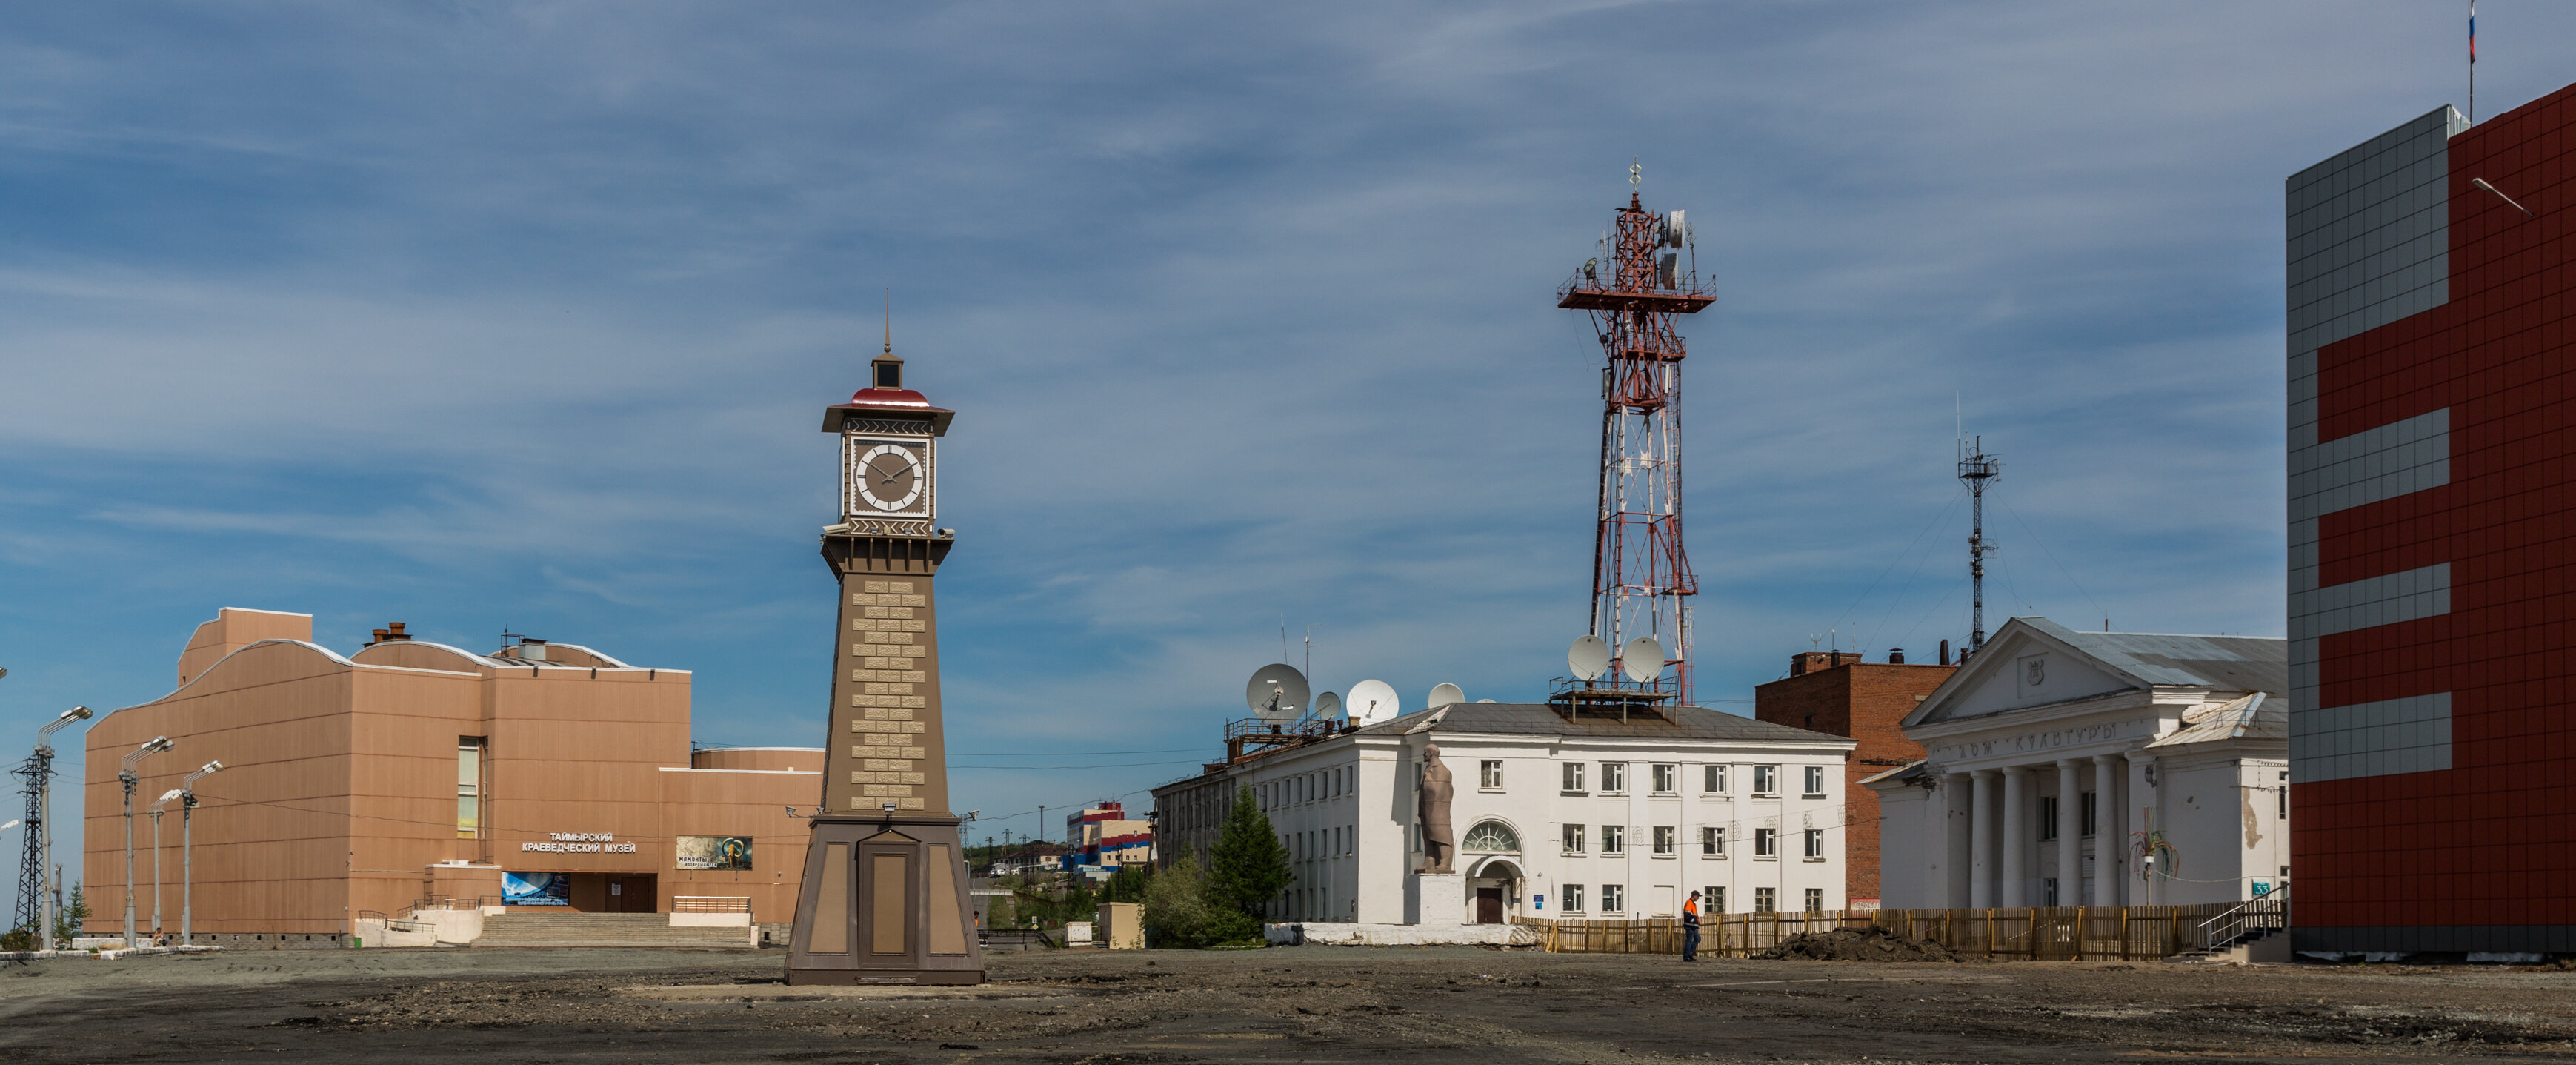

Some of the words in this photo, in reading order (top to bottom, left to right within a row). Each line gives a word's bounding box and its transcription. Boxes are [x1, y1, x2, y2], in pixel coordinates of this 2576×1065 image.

[1958, 742, 1993, 759] ДОМ
[2015, 724, 2117, 752] КУЛЬТУРЫ
[550, 832, 613, 842] ТАЙМЫРСКИЙ
[522, 843, 600, 853] КРАЕВЕДЧЕСКИЙ
[605, 843, 636, 853] МУЗЕЙ
[2255, 885, 2269, 895] 33
